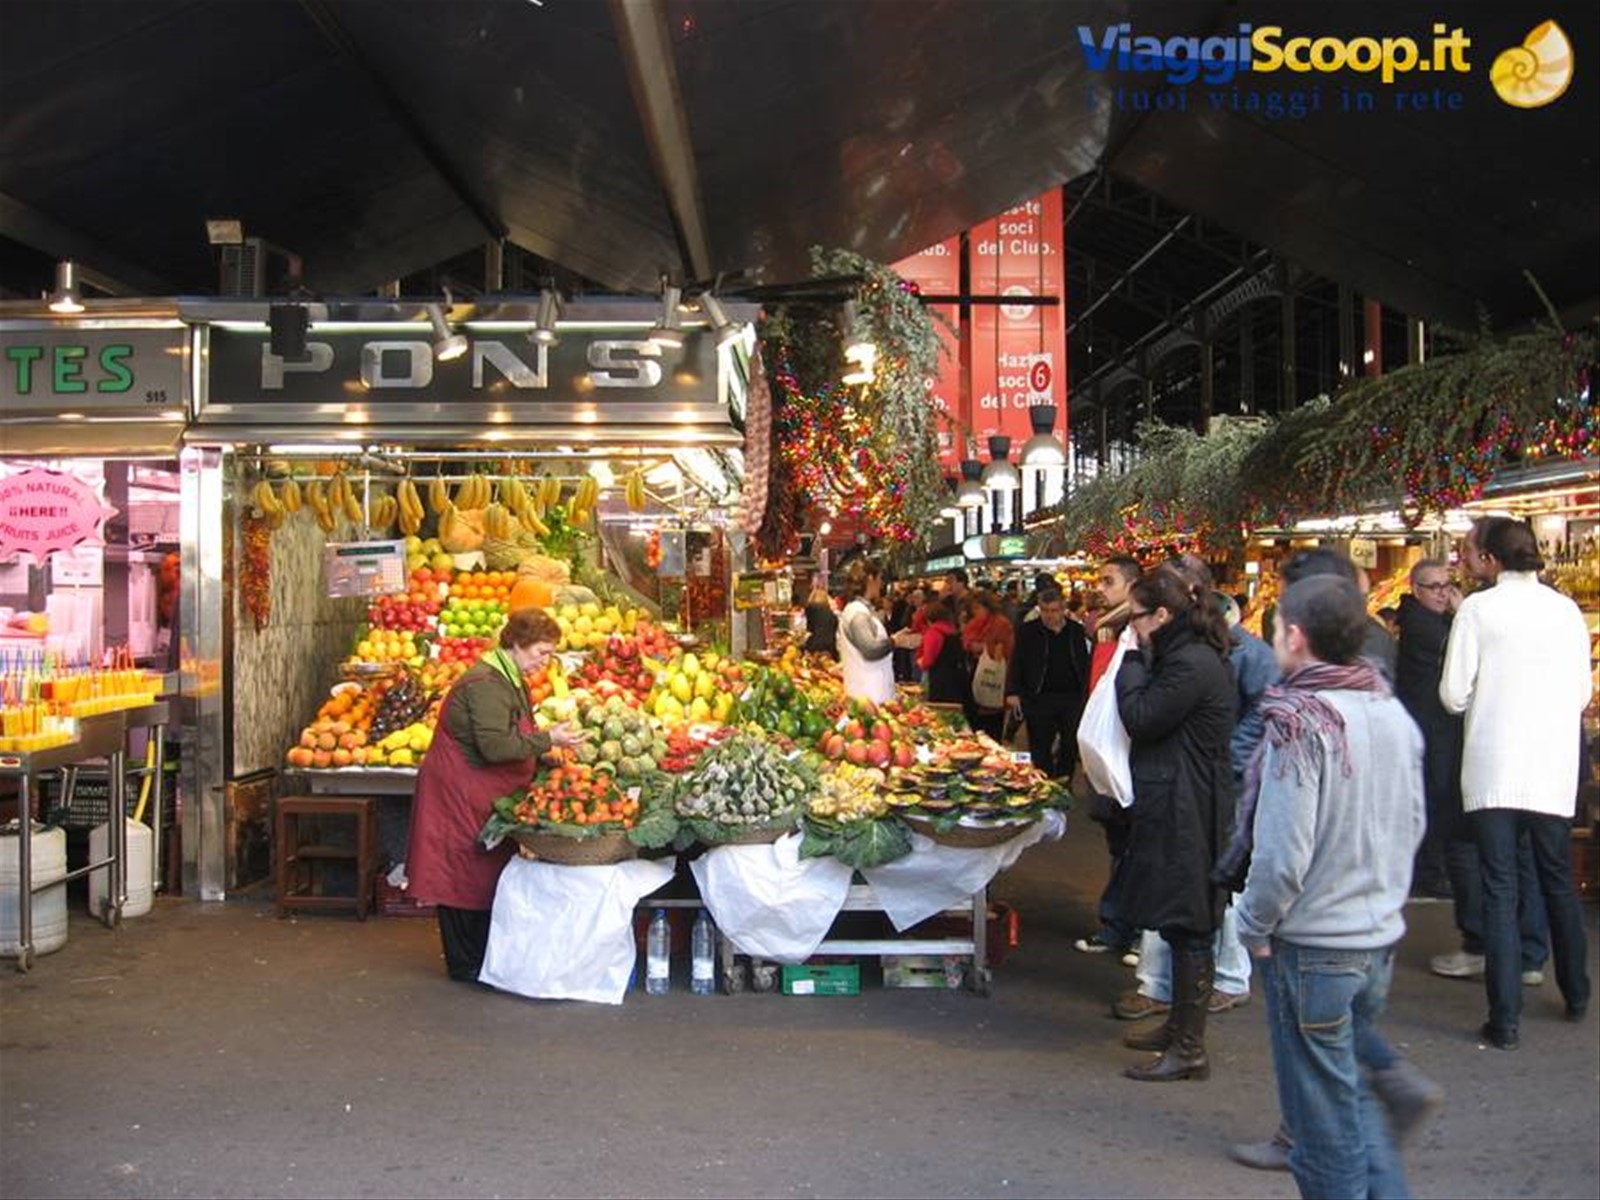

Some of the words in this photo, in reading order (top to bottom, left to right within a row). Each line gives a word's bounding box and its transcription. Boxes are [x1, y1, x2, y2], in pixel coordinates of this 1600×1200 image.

[999, 219, 1034, 235] soci
[977, 240, 1004, 255] del
[261, 340, 663, 389] PONS
[1035, 364, 1046, 388] 6
[980, 392, 1007, 409] del
[46, 522, 80, 541] JUICE
